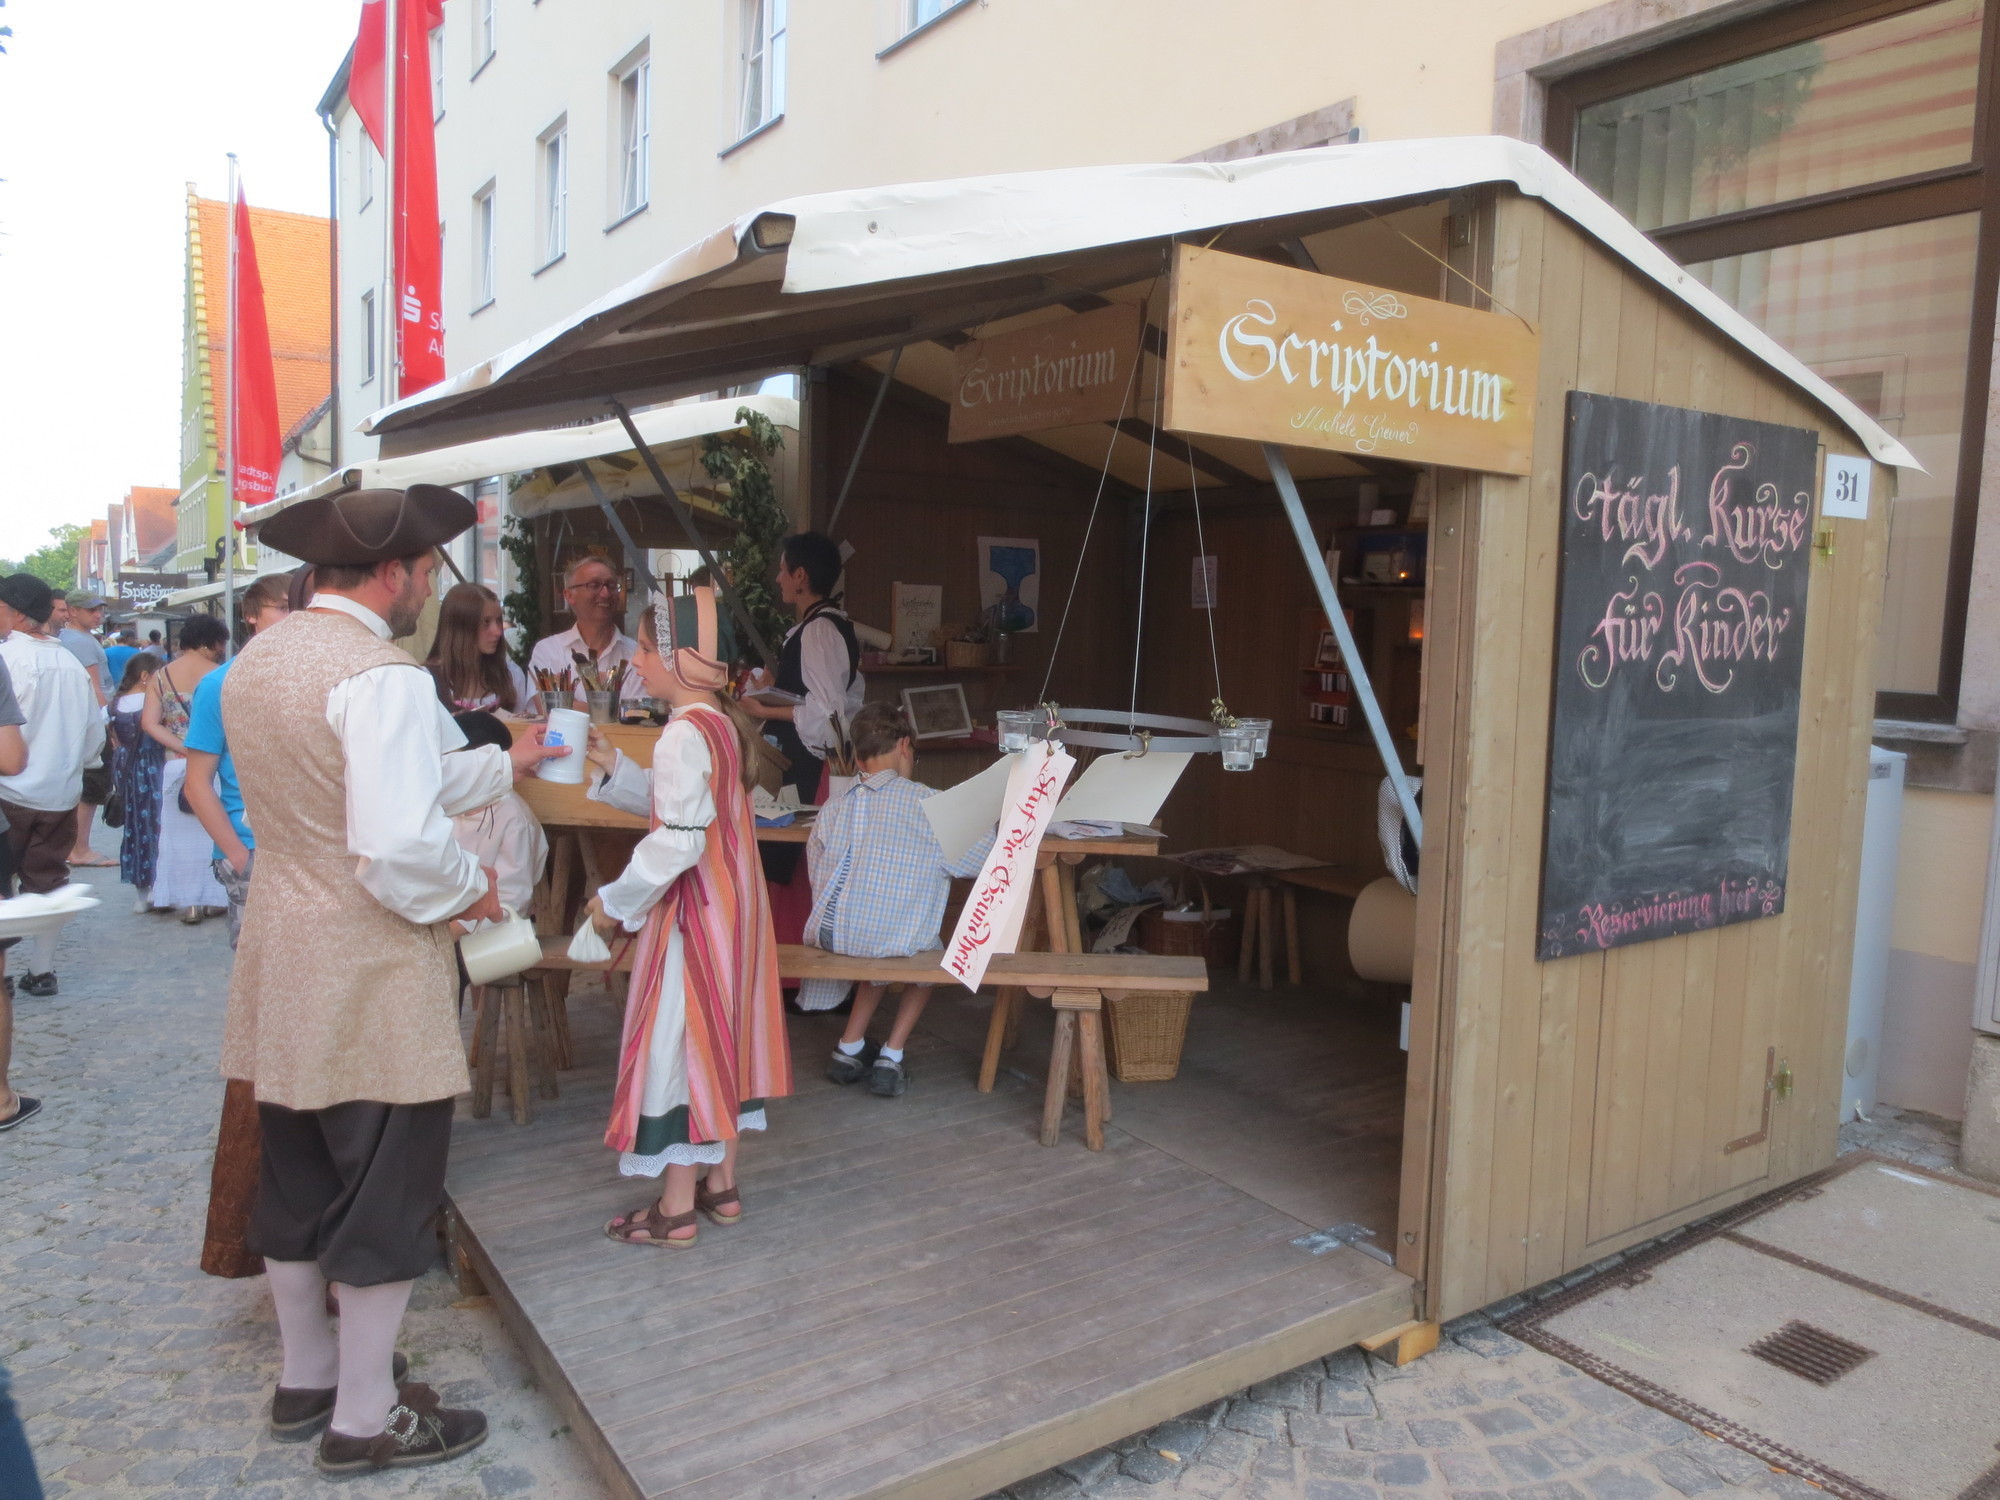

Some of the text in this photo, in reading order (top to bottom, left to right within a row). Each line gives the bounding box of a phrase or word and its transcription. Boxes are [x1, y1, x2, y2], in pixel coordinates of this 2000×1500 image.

[960, 340, 1115, 408] Scriptorium
[1219, 299, 1505, 423] Scriptorium
[1574, 442, 1809, 570] tägl. Kurse
[1835, 469, 1859, 502] 31
[1577, 562, 1791, 693] für Kinder
[1576, 874, 1758, 948] Reservierung hier
